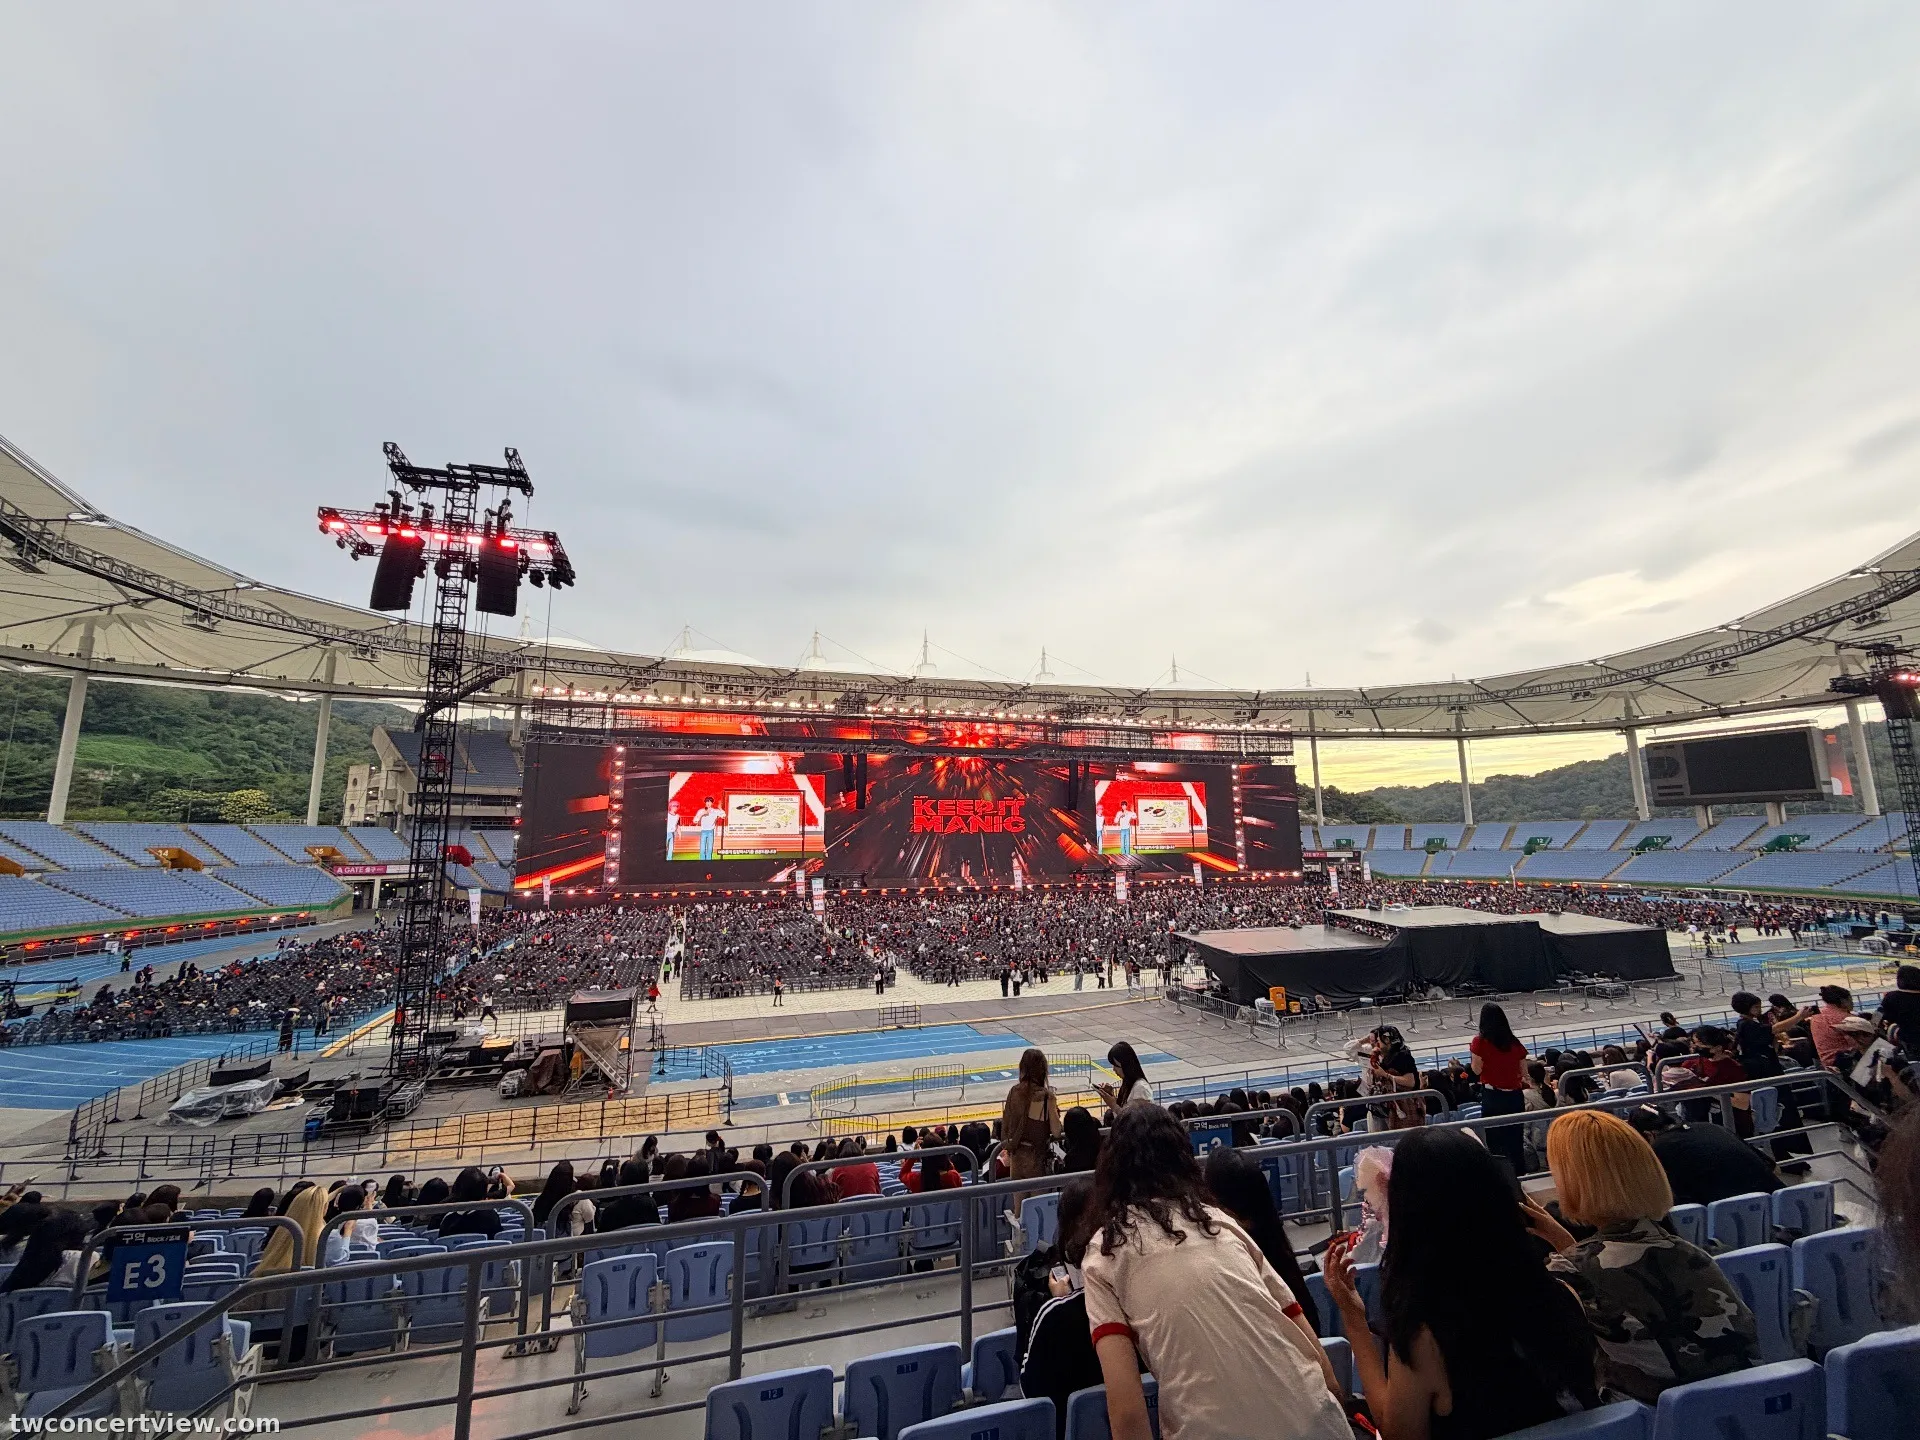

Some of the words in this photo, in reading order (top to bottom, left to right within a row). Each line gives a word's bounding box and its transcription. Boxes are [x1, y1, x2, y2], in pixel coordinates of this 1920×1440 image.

[914, 799, 995, 816] KEEP
[998, 799, 1026, 816] IT
[913, 815, 1026, 834] MANIC
[1193, 1121, 1207, 1131] 구역
[122, 1232, 146, 1244] 구역
[122, 1254, 166, 1289] E3
[767, 1388, 779, 1399] 12
